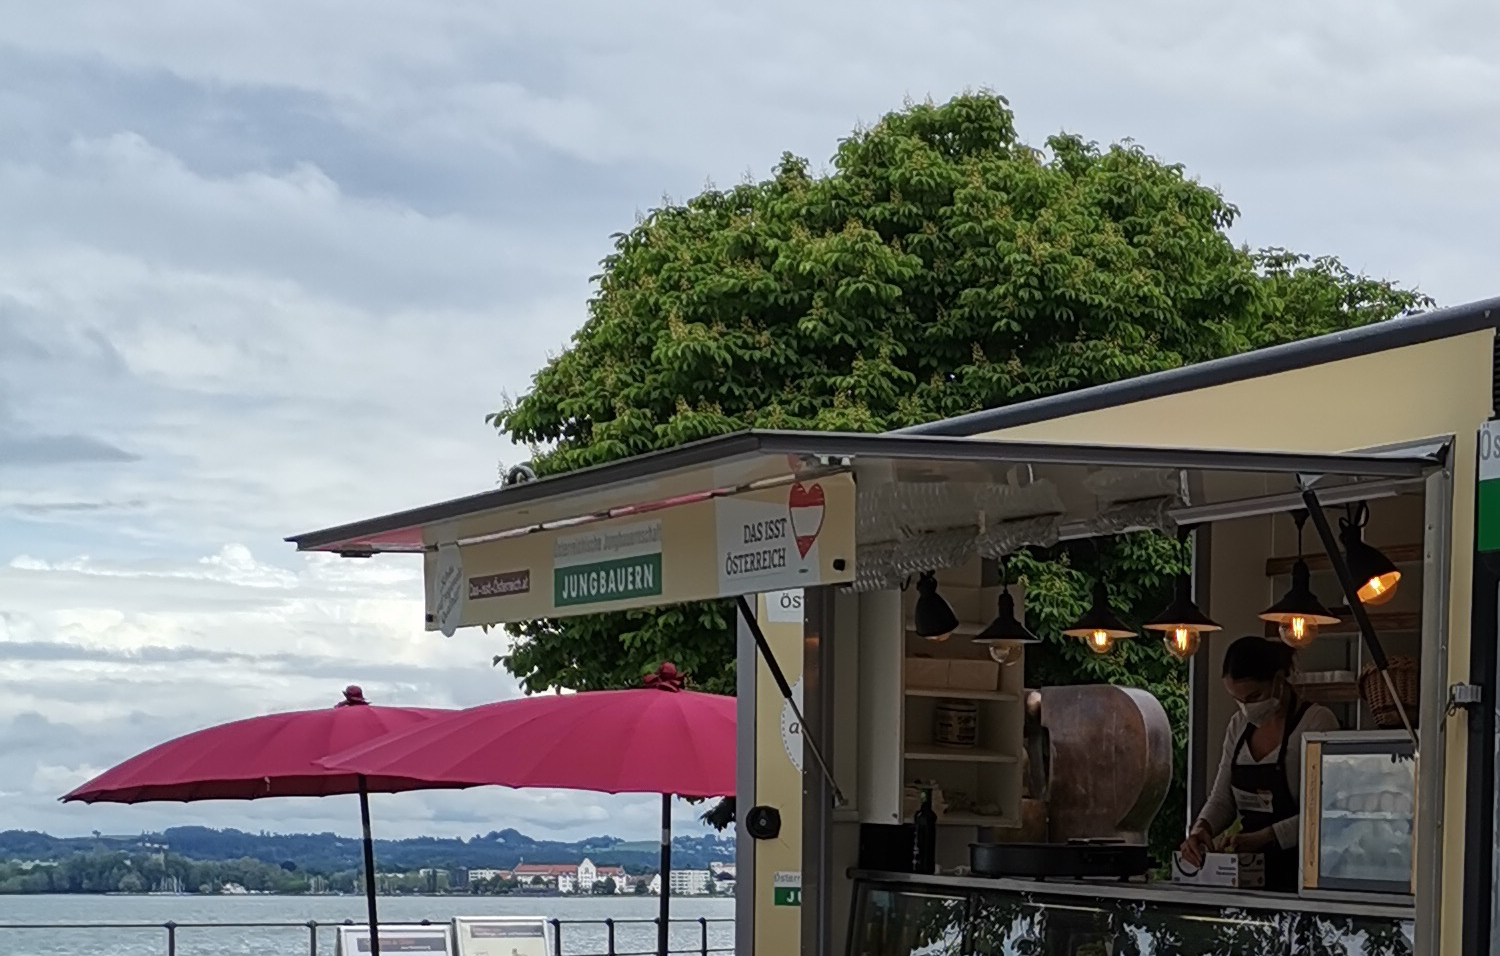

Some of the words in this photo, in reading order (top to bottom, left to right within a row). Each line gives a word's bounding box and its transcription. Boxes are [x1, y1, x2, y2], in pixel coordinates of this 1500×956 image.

[743, 522, 763, 544] DAS
[764, 518, 787, 541] ISST
[726, 547, 787, 576] ÖSTERREICH
[562, 563, 654, 600] JUNGBAUERN
[780, 592, 804, 609] ÖS
